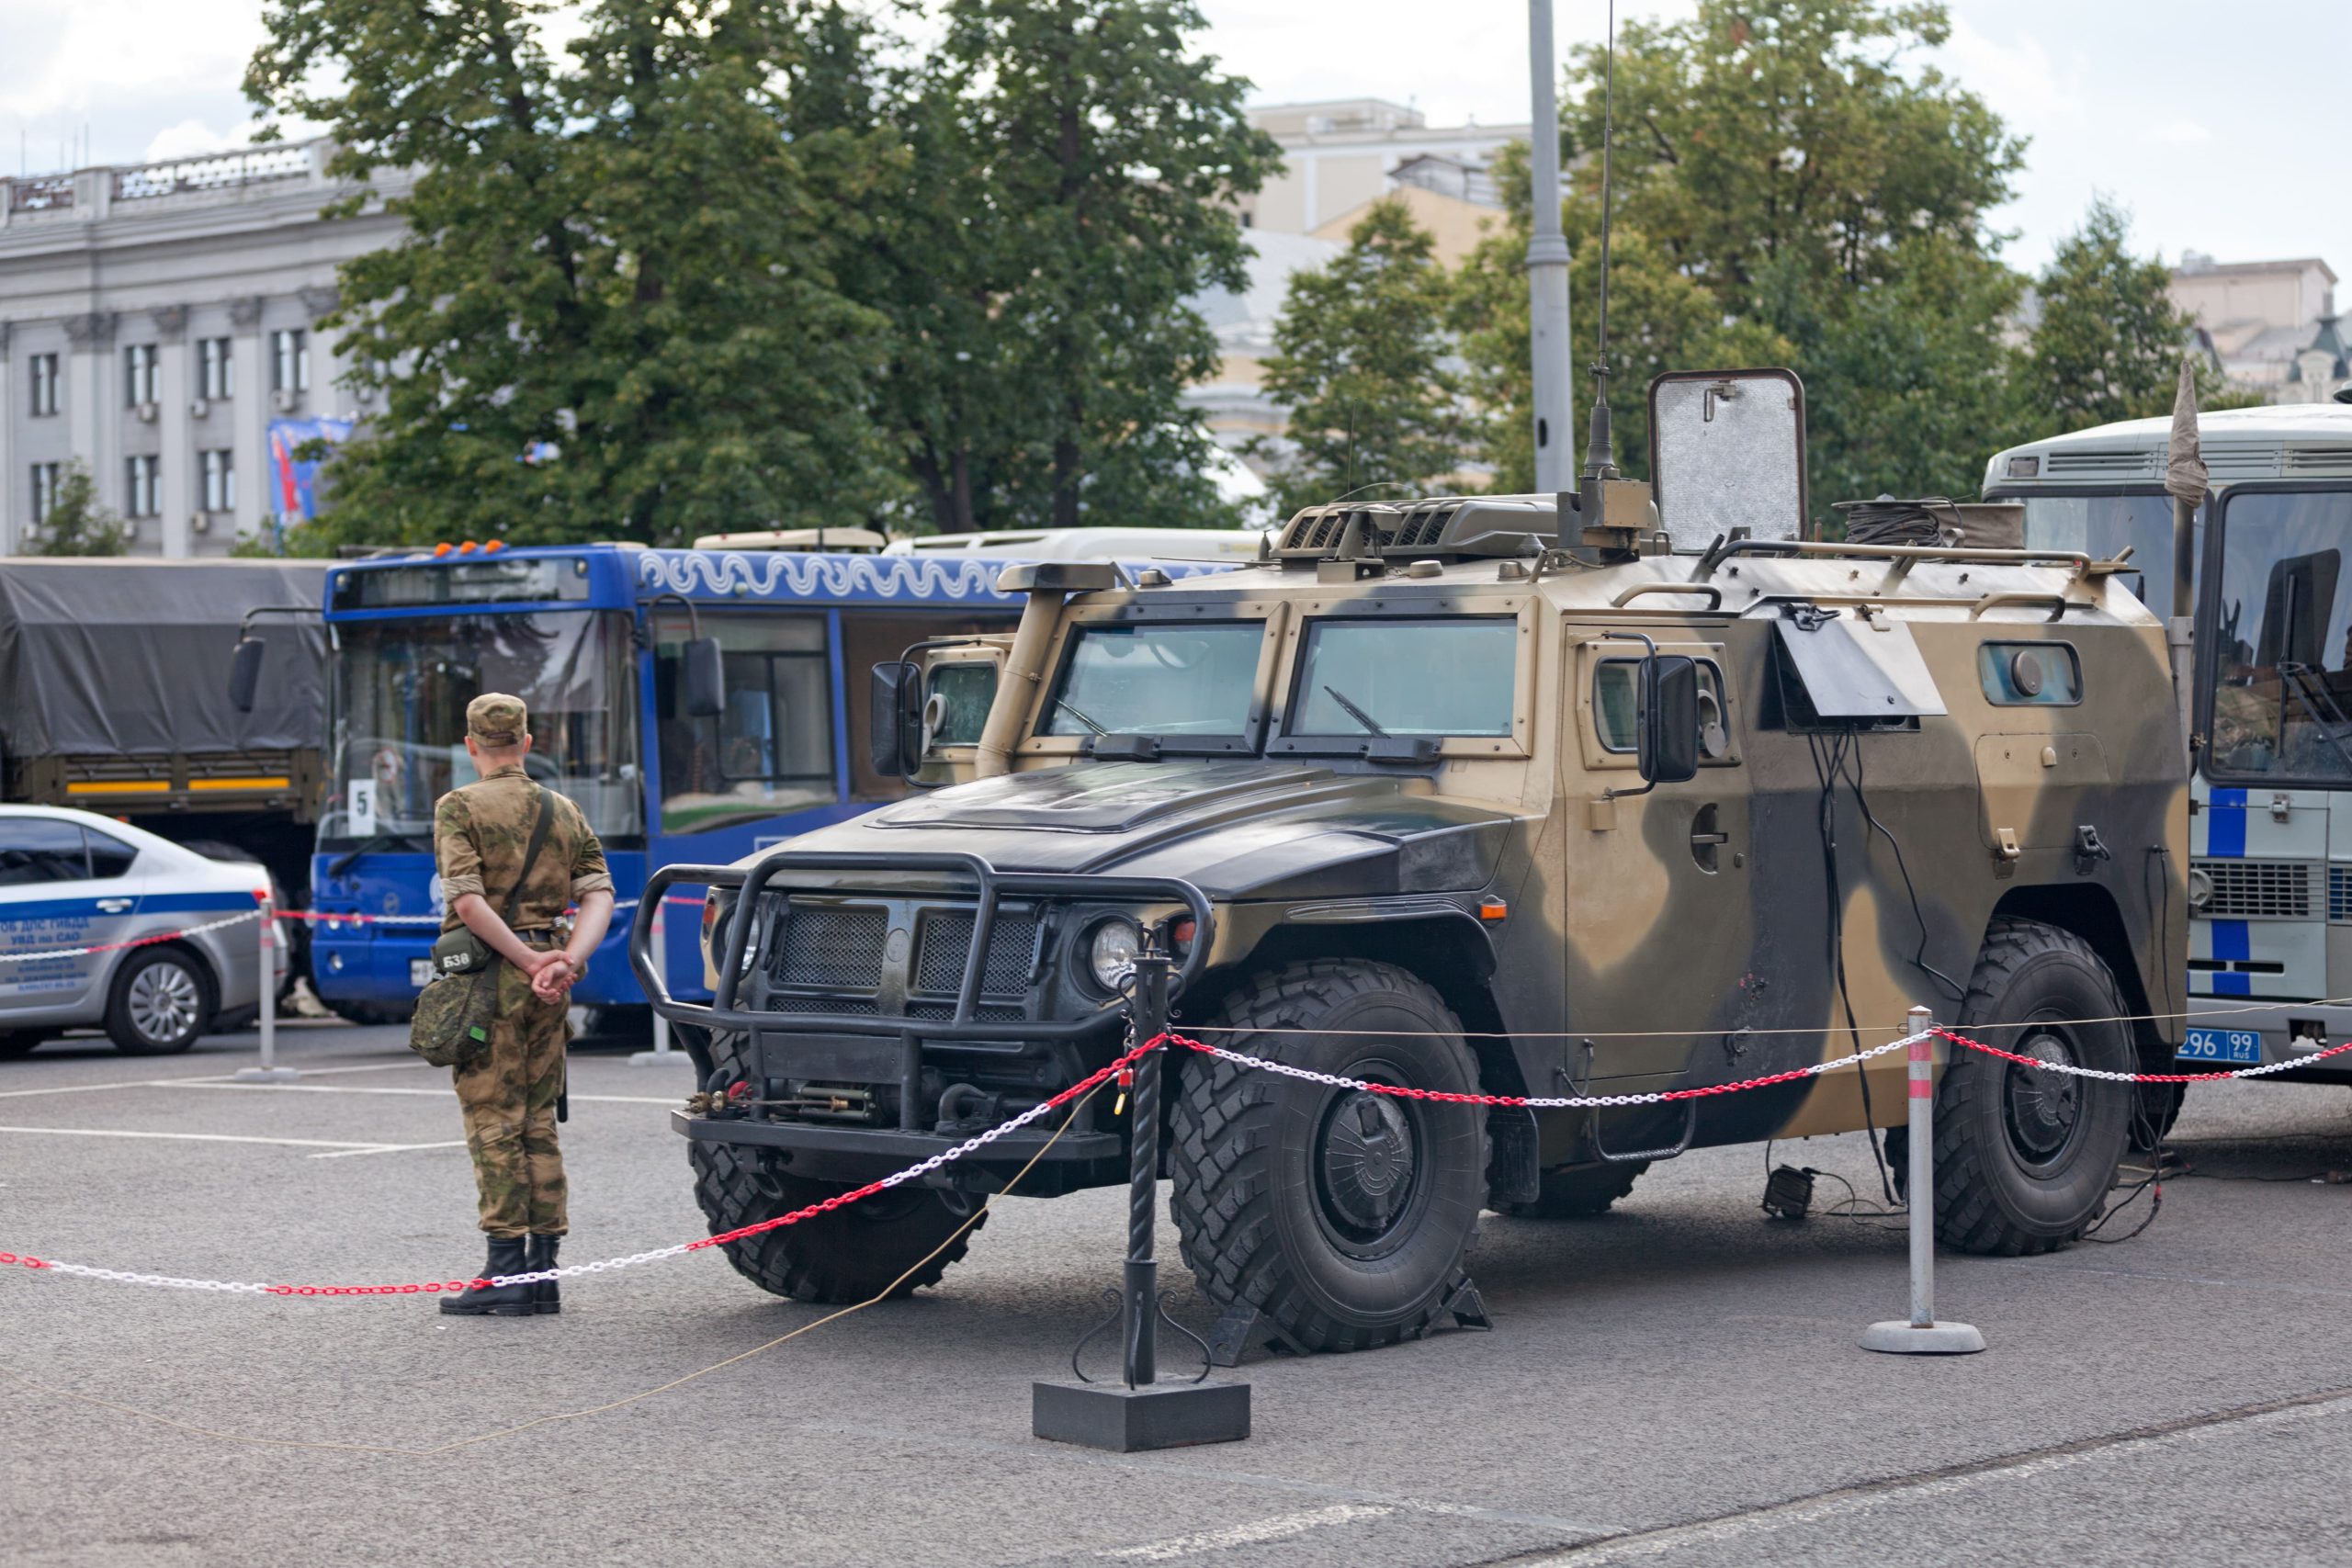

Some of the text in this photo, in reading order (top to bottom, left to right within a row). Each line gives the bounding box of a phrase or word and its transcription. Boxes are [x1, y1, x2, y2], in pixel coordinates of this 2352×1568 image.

[356, 791, 368, 817] 5
[21, 919, 46, 932] ДПС
[56, 931, 81, 942] САО
[2230, 1033, 2252, 1052] 99
[2233, 1051, 2250, 1059] RUS
